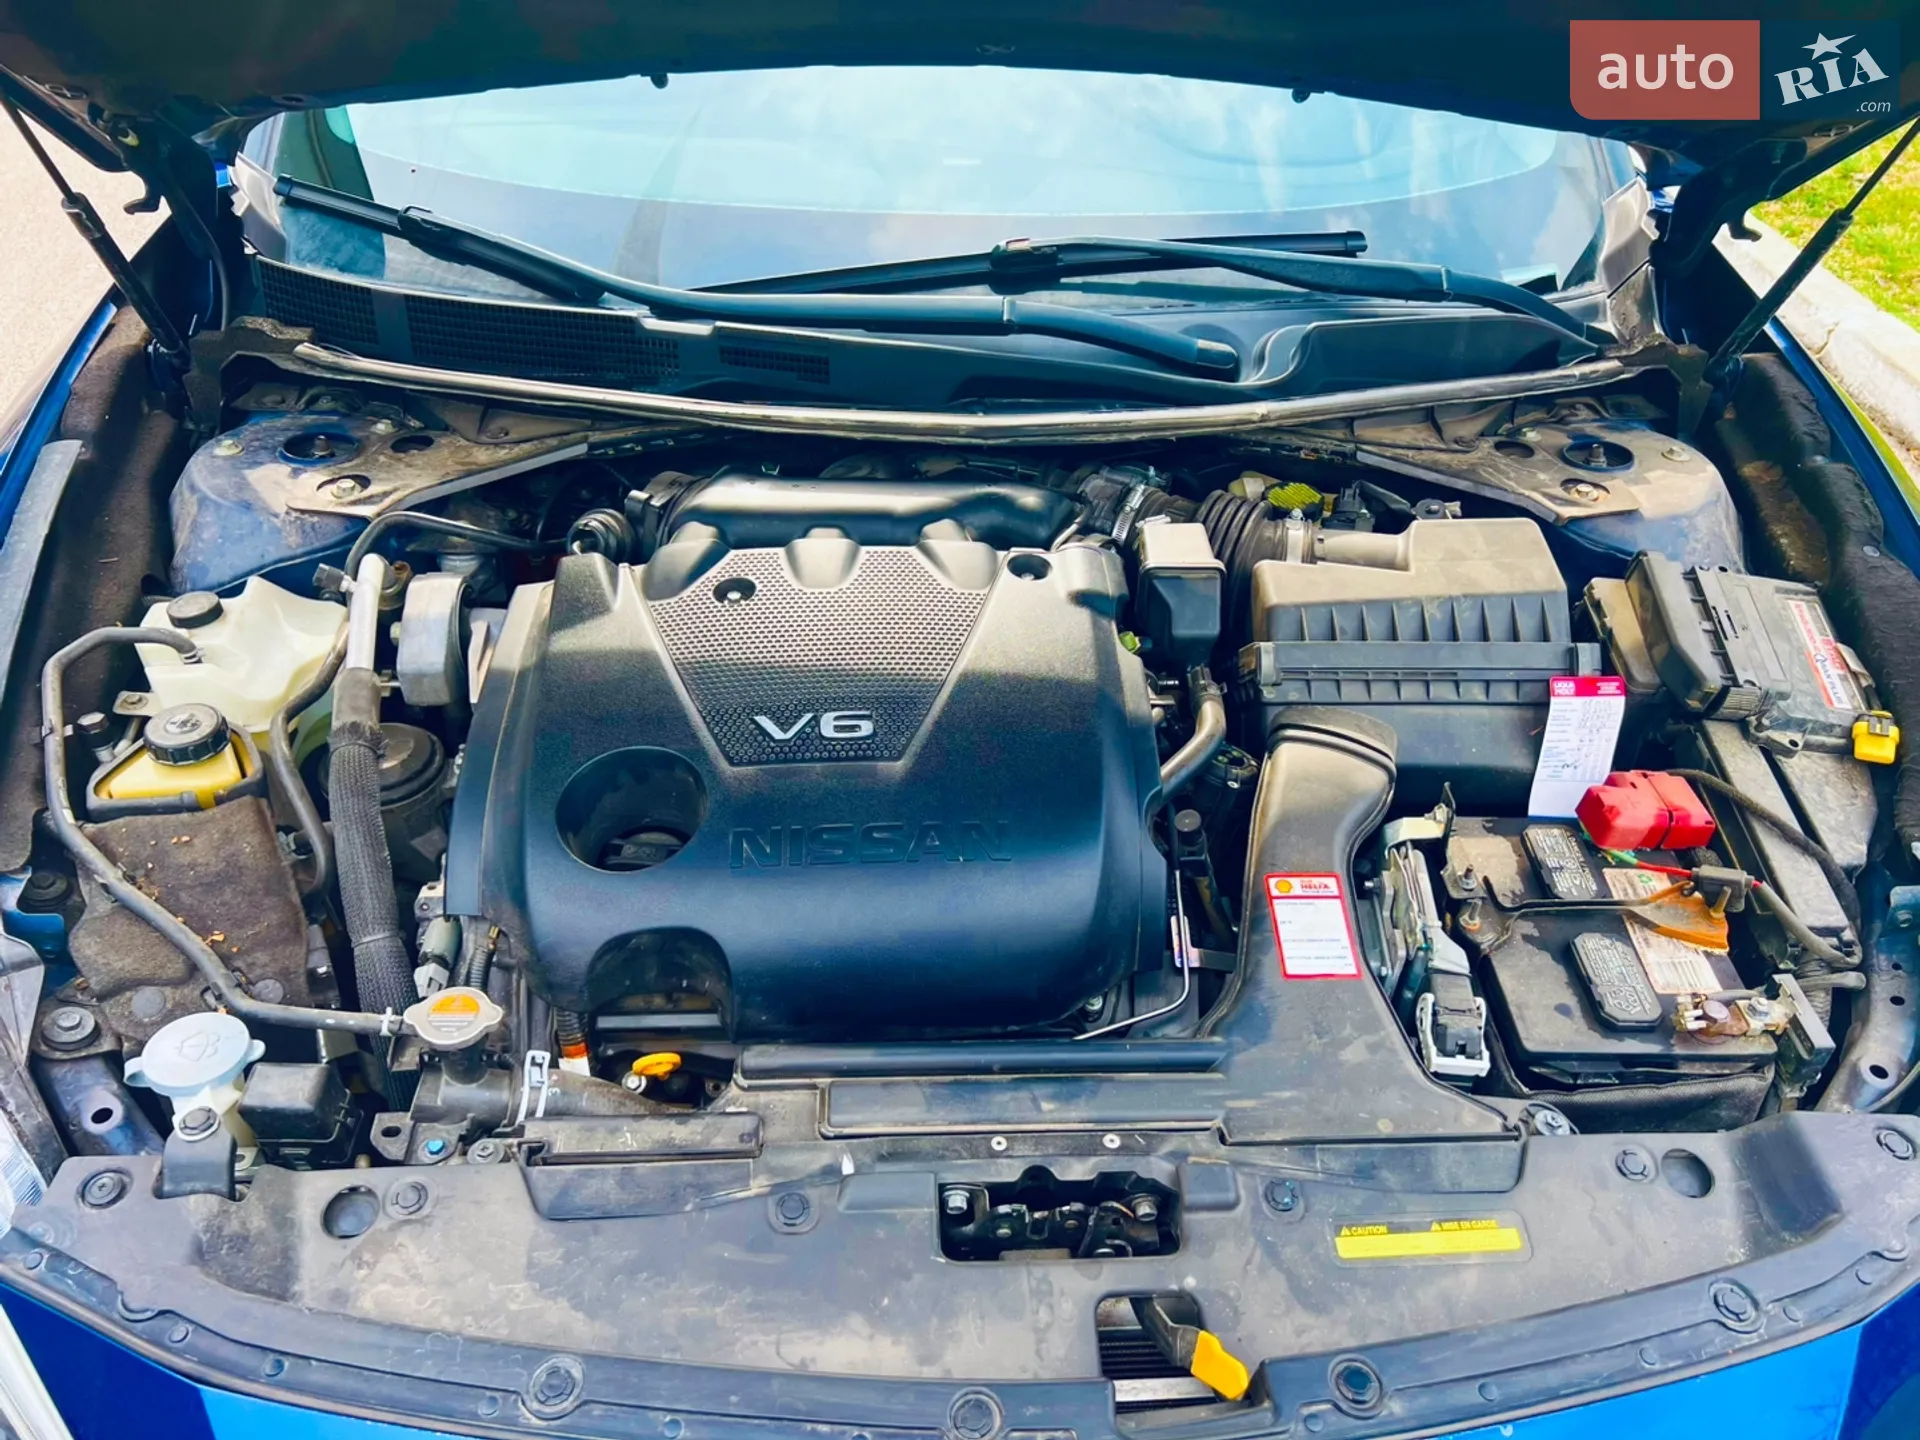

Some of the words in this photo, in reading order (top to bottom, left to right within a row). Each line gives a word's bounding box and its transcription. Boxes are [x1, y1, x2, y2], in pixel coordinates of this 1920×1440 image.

[752, 709, 875, 742] V6
[729, 821, 1013, 869] NISSAN
[1350, 1224, 1389, 1236] CAUTION
